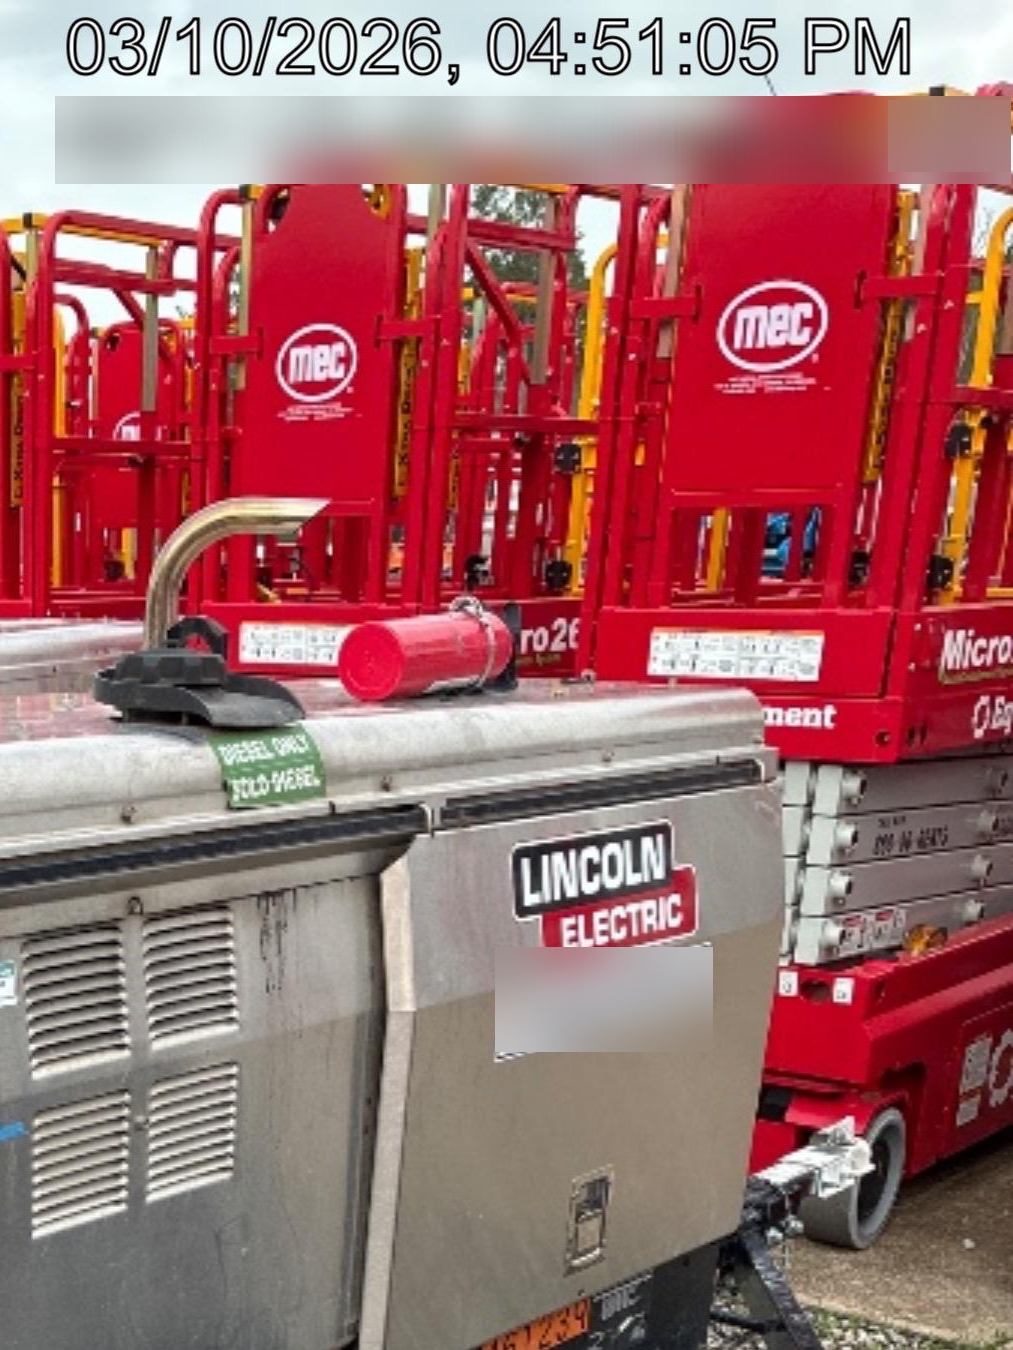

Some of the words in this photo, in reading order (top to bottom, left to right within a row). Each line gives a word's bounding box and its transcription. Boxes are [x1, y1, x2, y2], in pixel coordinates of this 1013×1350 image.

[733, 301, 814, 350] mec
[289, 341, 346, 385] mec
[944, 629, 1013, 670] Micro
[520, 833, 667, 907] LINCOLN
[559, 893, 684, 948] ELECTRIC
